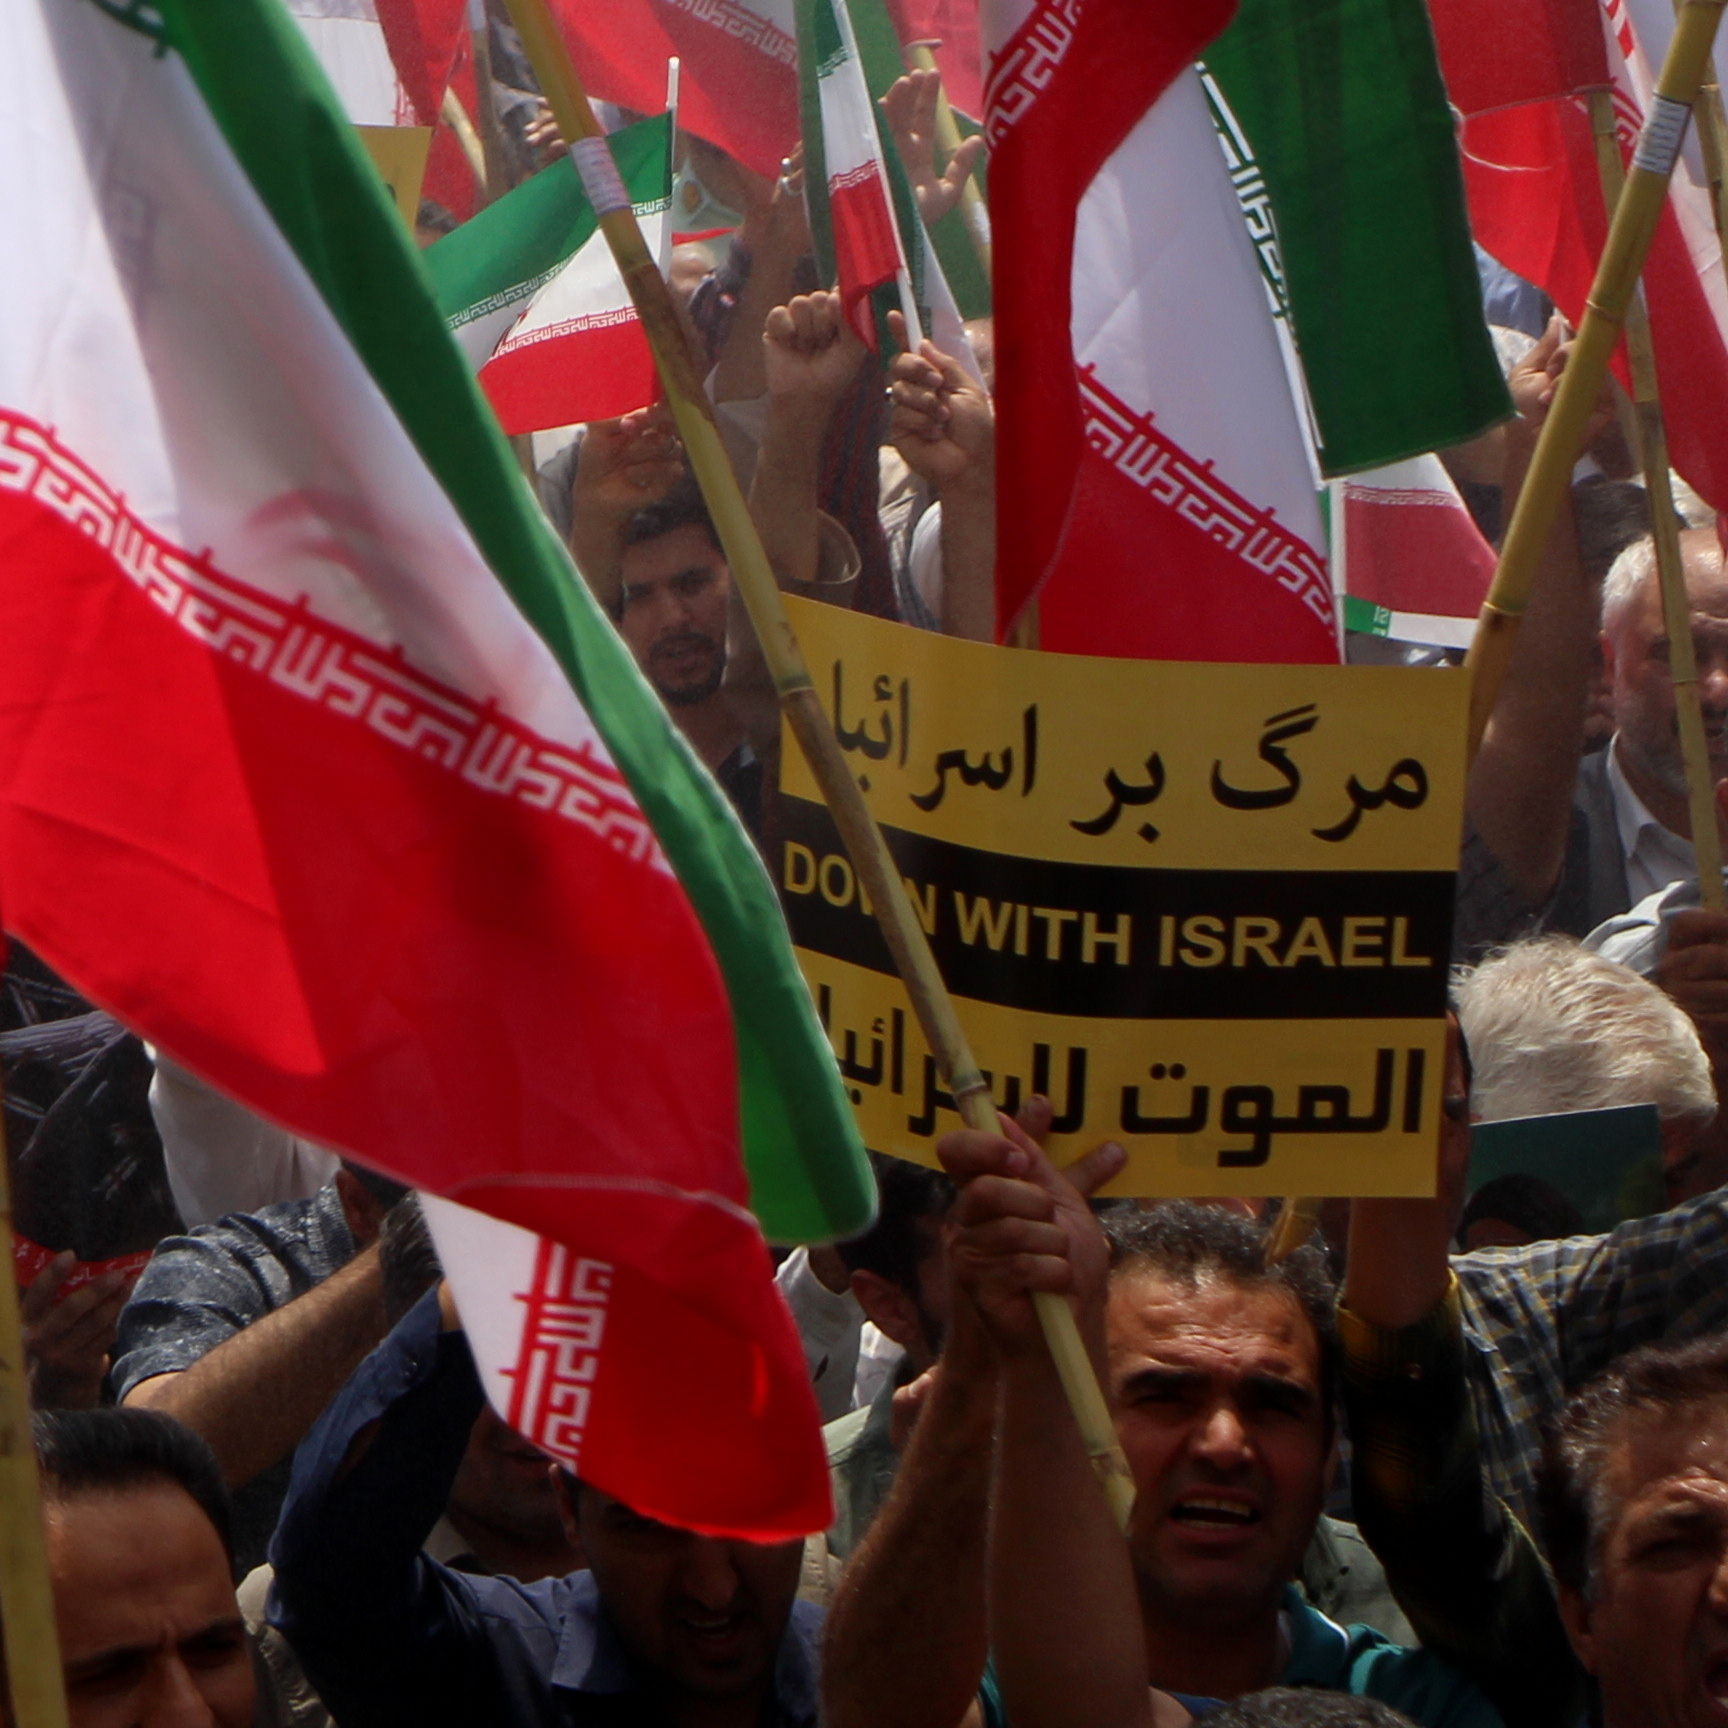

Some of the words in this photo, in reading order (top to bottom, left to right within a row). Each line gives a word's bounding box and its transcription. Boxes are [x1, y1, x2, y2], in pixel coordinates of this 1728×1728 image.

[1069, 750, 1166, 843] بر
[1210, 704, 1430, 842] مرگ
[953, 889, 1132, 967] WITH
[1157, 915, 1432, 968] ISRAEL
[1119, 1047, 1426, 1169] الموت
